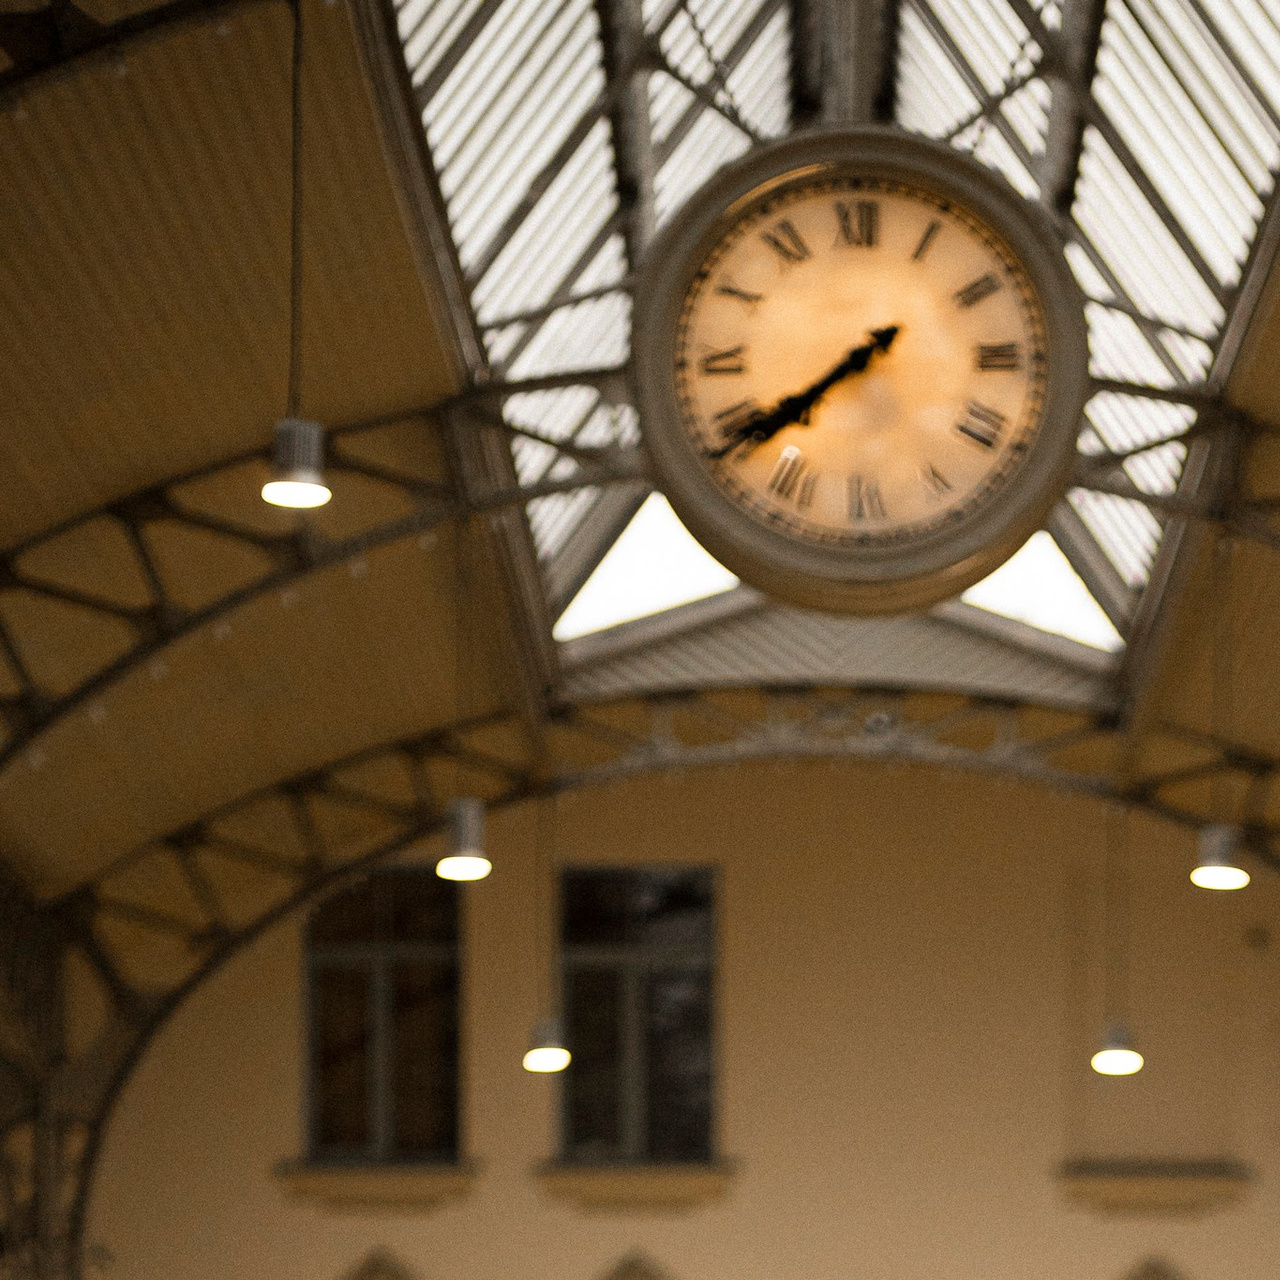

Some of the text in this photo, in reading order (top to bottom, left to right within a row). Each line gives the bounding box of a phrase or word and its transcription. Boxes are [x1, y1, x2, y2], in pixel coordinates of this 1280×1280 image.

[834, 200, 880, 248] XII
[913, 220, 941, 262] I
[977, 344, 1020, 371] III
